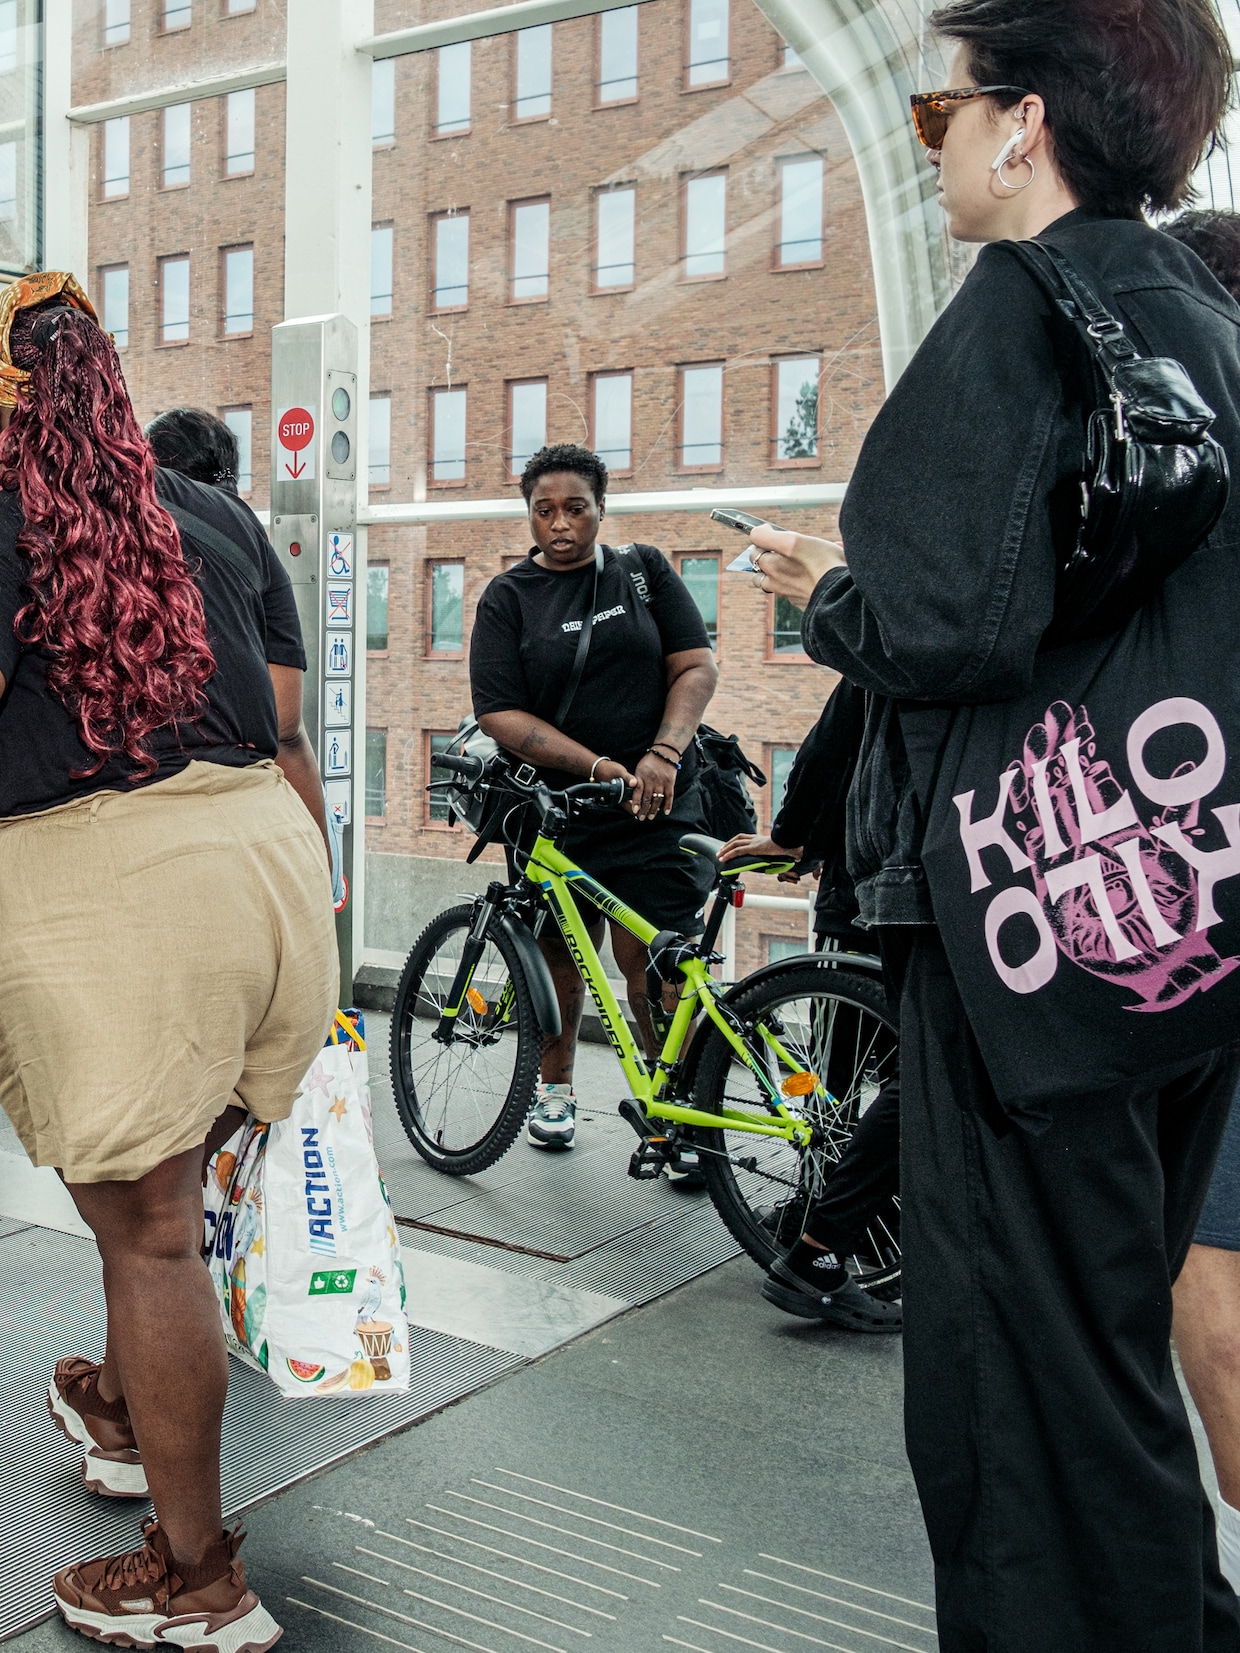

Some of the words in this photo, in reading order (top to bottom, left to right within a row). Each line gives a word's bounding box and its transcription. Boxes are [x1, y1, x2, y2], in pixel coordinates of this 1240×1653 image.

[282, 422, 310, 437] STOP
[952, 697, 1227, 895] KILO
[565, 933, 626, 1060] ROCKRIDER
[301, 1127, 335, 1240] ACTION
[326, 1146, 348, 1233] www.action.com
